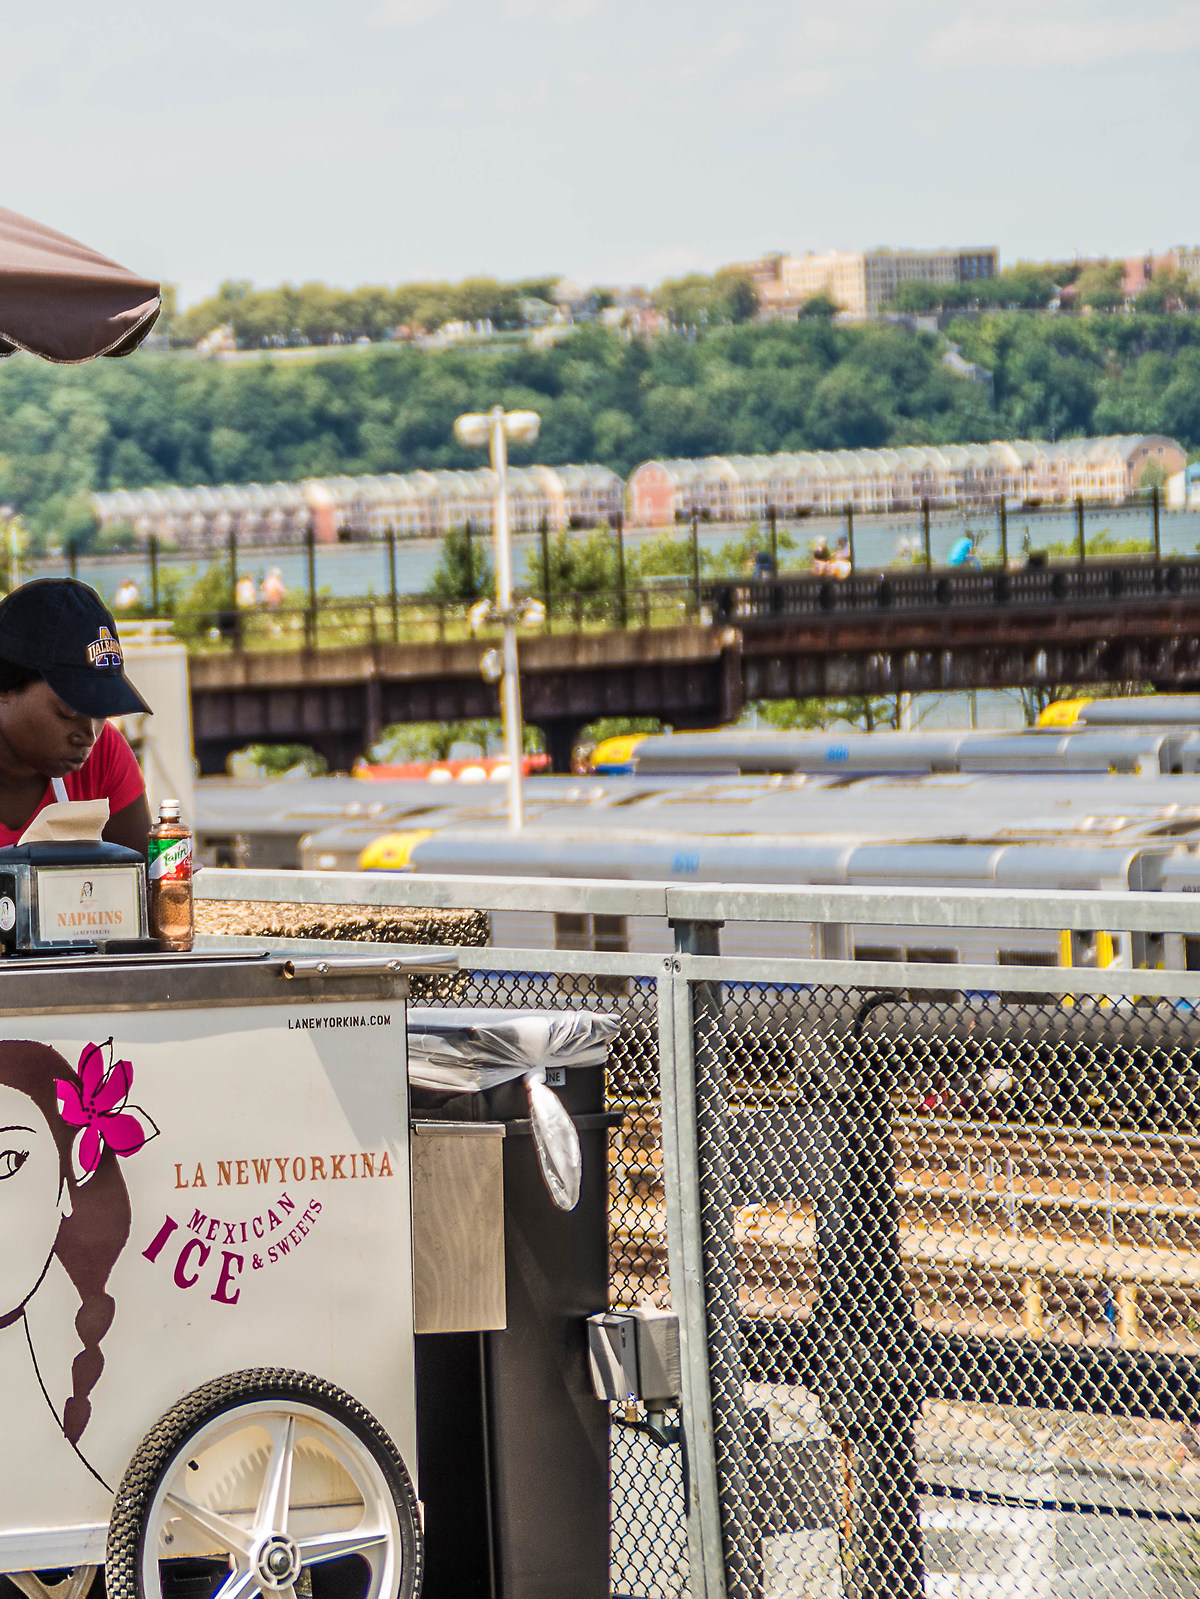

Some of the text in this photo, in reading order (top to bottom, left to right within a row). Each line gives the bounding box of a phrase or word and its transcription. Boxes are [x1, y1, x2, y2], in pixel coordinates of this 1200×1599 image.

[57, 910, 123, 927] NAPKINS
[288, 1015, 391, 1030] LANEWYORKINA.COM
[174, 1151, 394, 1189] LA NEWYORKINA
[186, 1191, 296, 1245] MEXICAN
[141, 1198, 323, 1305] ICE & SWEETS
